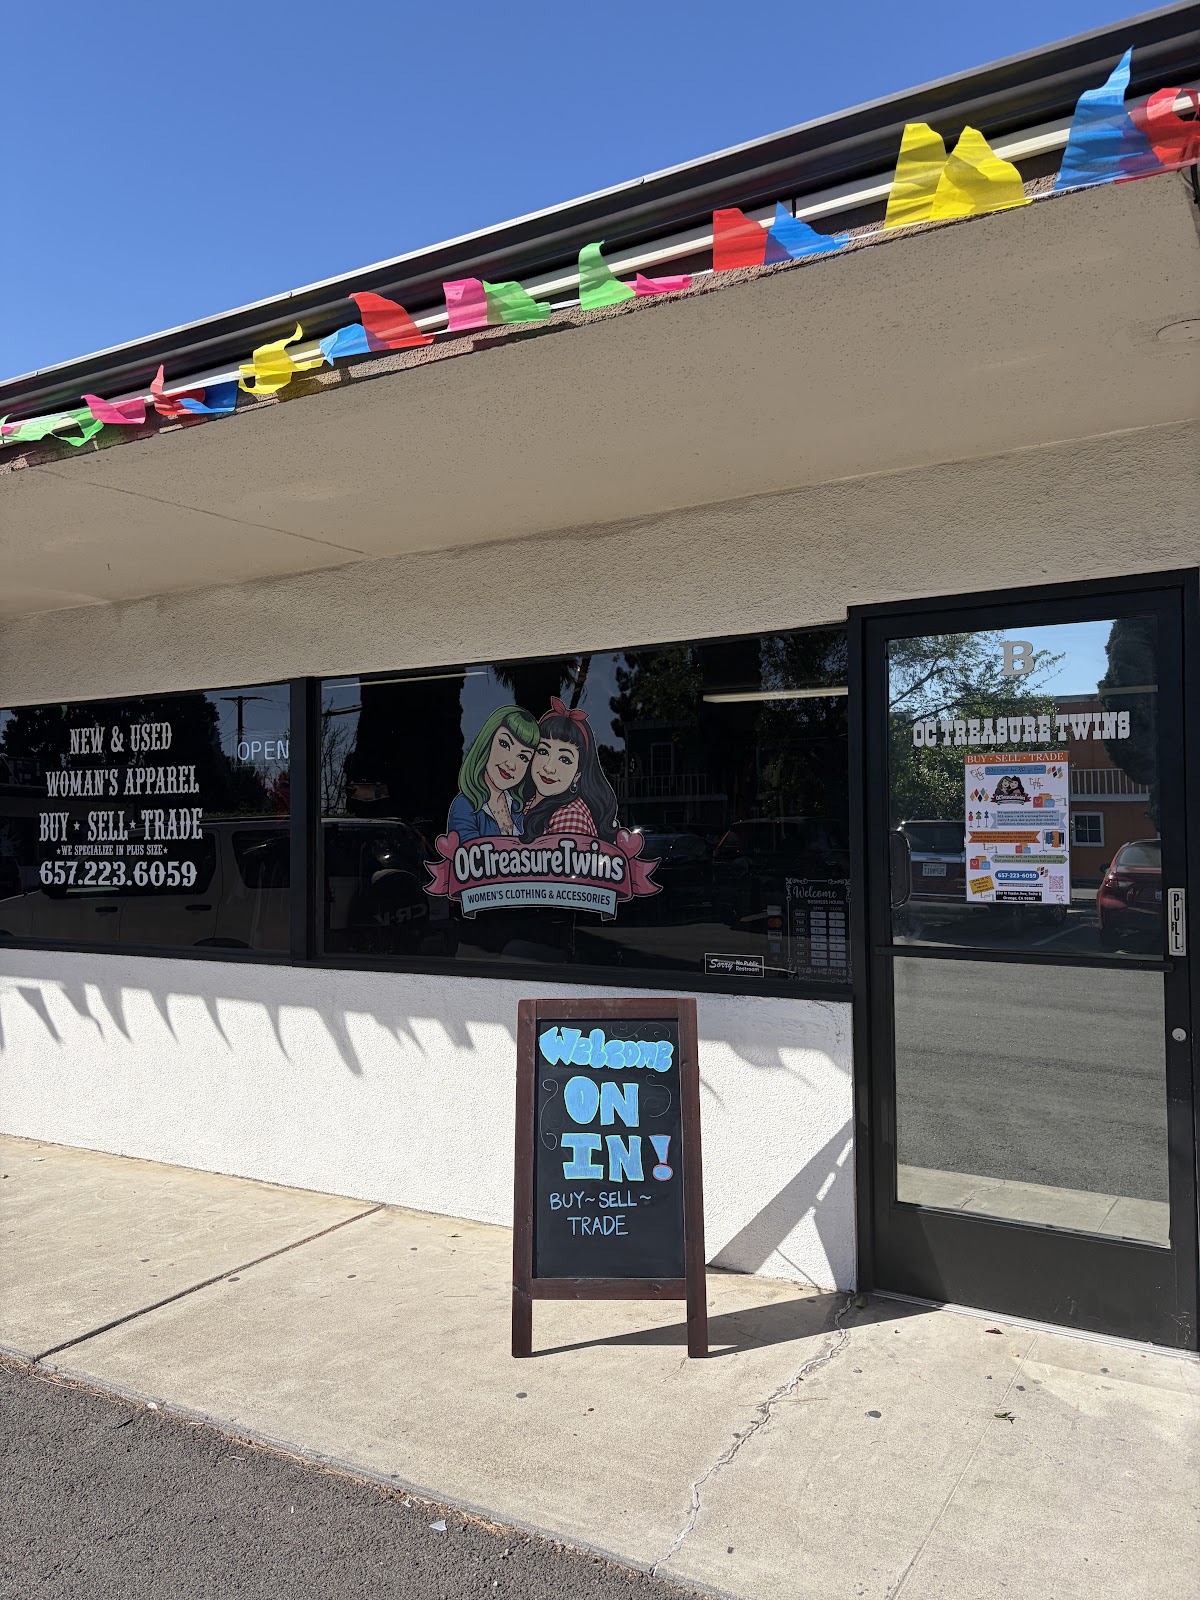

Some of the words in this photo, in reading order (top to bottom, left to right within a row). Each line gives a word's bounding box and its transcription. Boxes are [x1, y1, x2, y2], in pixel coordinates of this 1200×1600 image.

[1000, 640, 1034, 676] B
[69, 726, 105, 755] NEW
[110, 726, 124, 753] &
[130, 722, 172, 752] USED
[912, 723, 937, 747] OC
[940, 716, 1050, 746] TREASURE
[1056, 711, 1131, 741] TWINS
[237, 740, 290, 761] OPEN
[995, 754, 1020, 763] SELL
[1029, 752, 1064, 761] TRADE
[46, 768, 118, 797] WOMAN'S
[123, 765, 200, 795] APPAREL
[39, 812, 70, 842] BUY
[87, 810, 129, 841] SELL
[141, 808, 203, 840] TRADE
[61, 845, 73, 856] WE
[74, 844, 113, 856] SPECIALIZE
[116, 844, 124, 856] IN
[126, 844, 144, 856] PLUS
[147, 844, 163, 855] SIZE
[454, 840, 624, 881] OCTreasureTwins
[39, 861, 198, 887] 657.223.6059
[467, 890, 504, 904] WOMEN'S
[505, 889, 547, 900] CLOTHING
[548, 890, 555, 899] &
[556, 890, 611, 906] ACCESSORIES
[793, 886, 838, 899] Welcome
[1172, 893, 1181, 950] PULL
[709, 958, 733, 971] Sorry
[538, 1026, 674, 1072] Welcome
[564, 1075, 640, 1127] ON
[560, 1132, 673, 1183] IN!
[567, 1214, 629, 1236] TRADE
